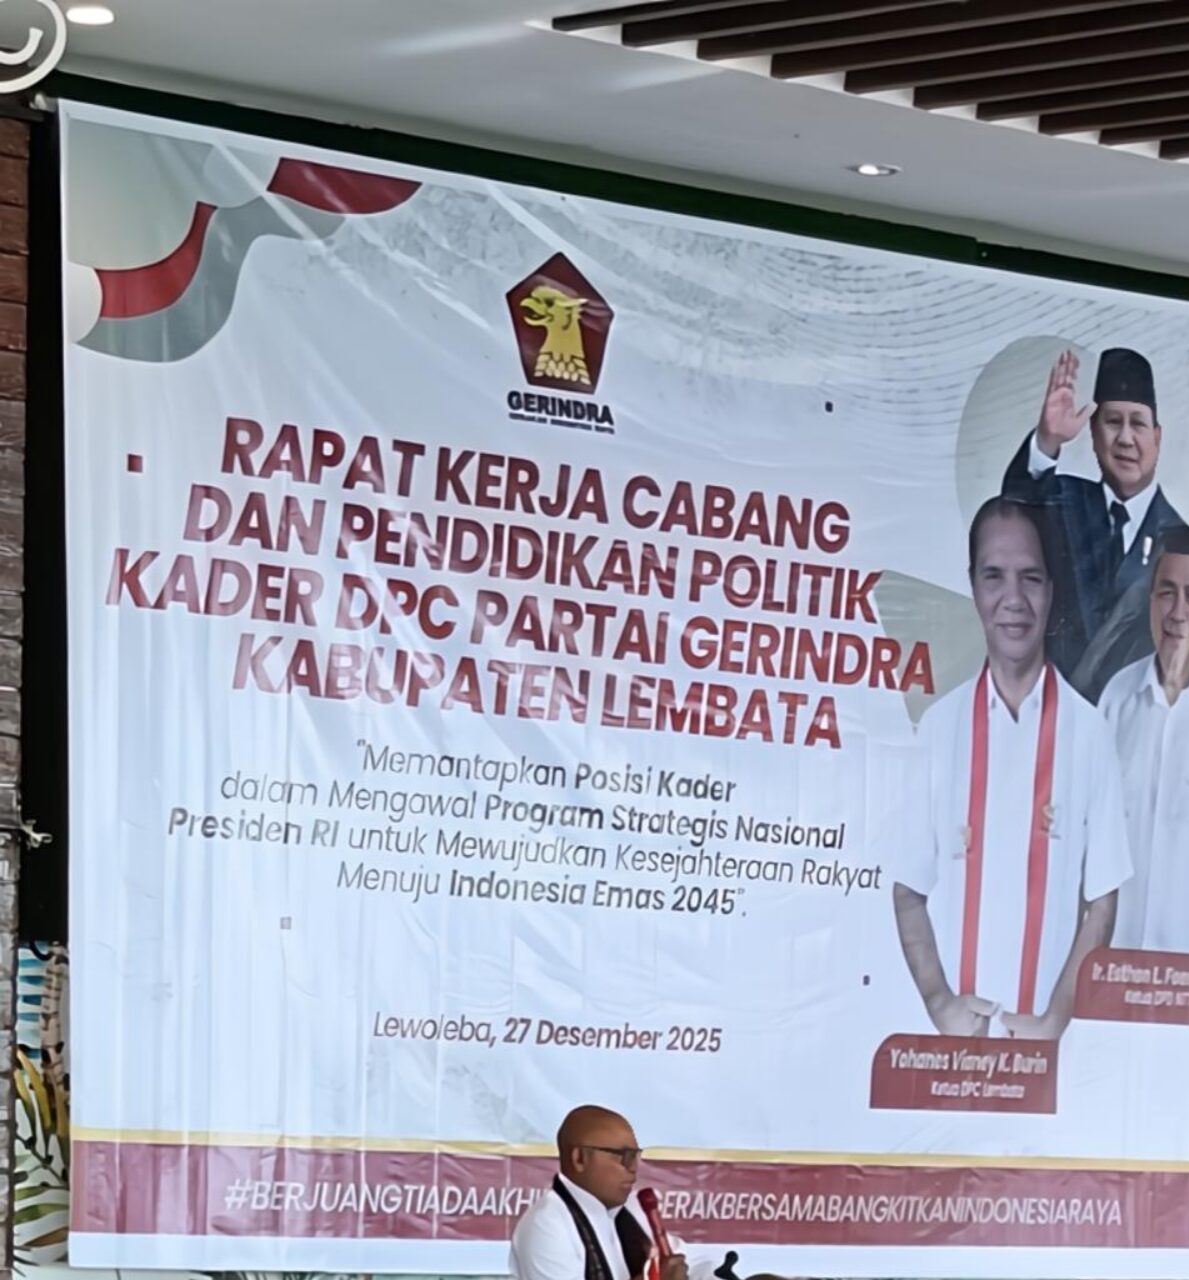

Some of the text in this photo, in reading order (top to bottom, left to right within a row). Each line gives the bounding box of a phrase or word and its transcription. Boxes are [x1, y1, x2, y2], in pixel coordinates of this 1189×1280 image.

[507, 390, 615, 426] GERINDRA
[221, 416, 851, 554] RAPAT KERJA CABANG
[183, 483, 883, 625] DAN PENDIDIKAN POLITIK
[105, 547, 936, 696] KADER DPC PARTAI GERINDRA
[232, 632, 843, 750] KABUPATEN LEMBATA
[220, 770, 846, 850] dalam Mengawal Program Strategis Nasional
[574, 762, 653, 795] Posisi
[657, 770, 737, 803] Kader
[168, 807, 882, 896] Presiden RI untuk Mewujudkan Kesejahteraan Rakyat
[336, 860, 441, 904] Menuju
[449, 869, 586, 905] Indonesia
[591, 879, 666, 912] Emas
[373, 1011, 723, 1053] Lewoleba, 27 Desember 2025
